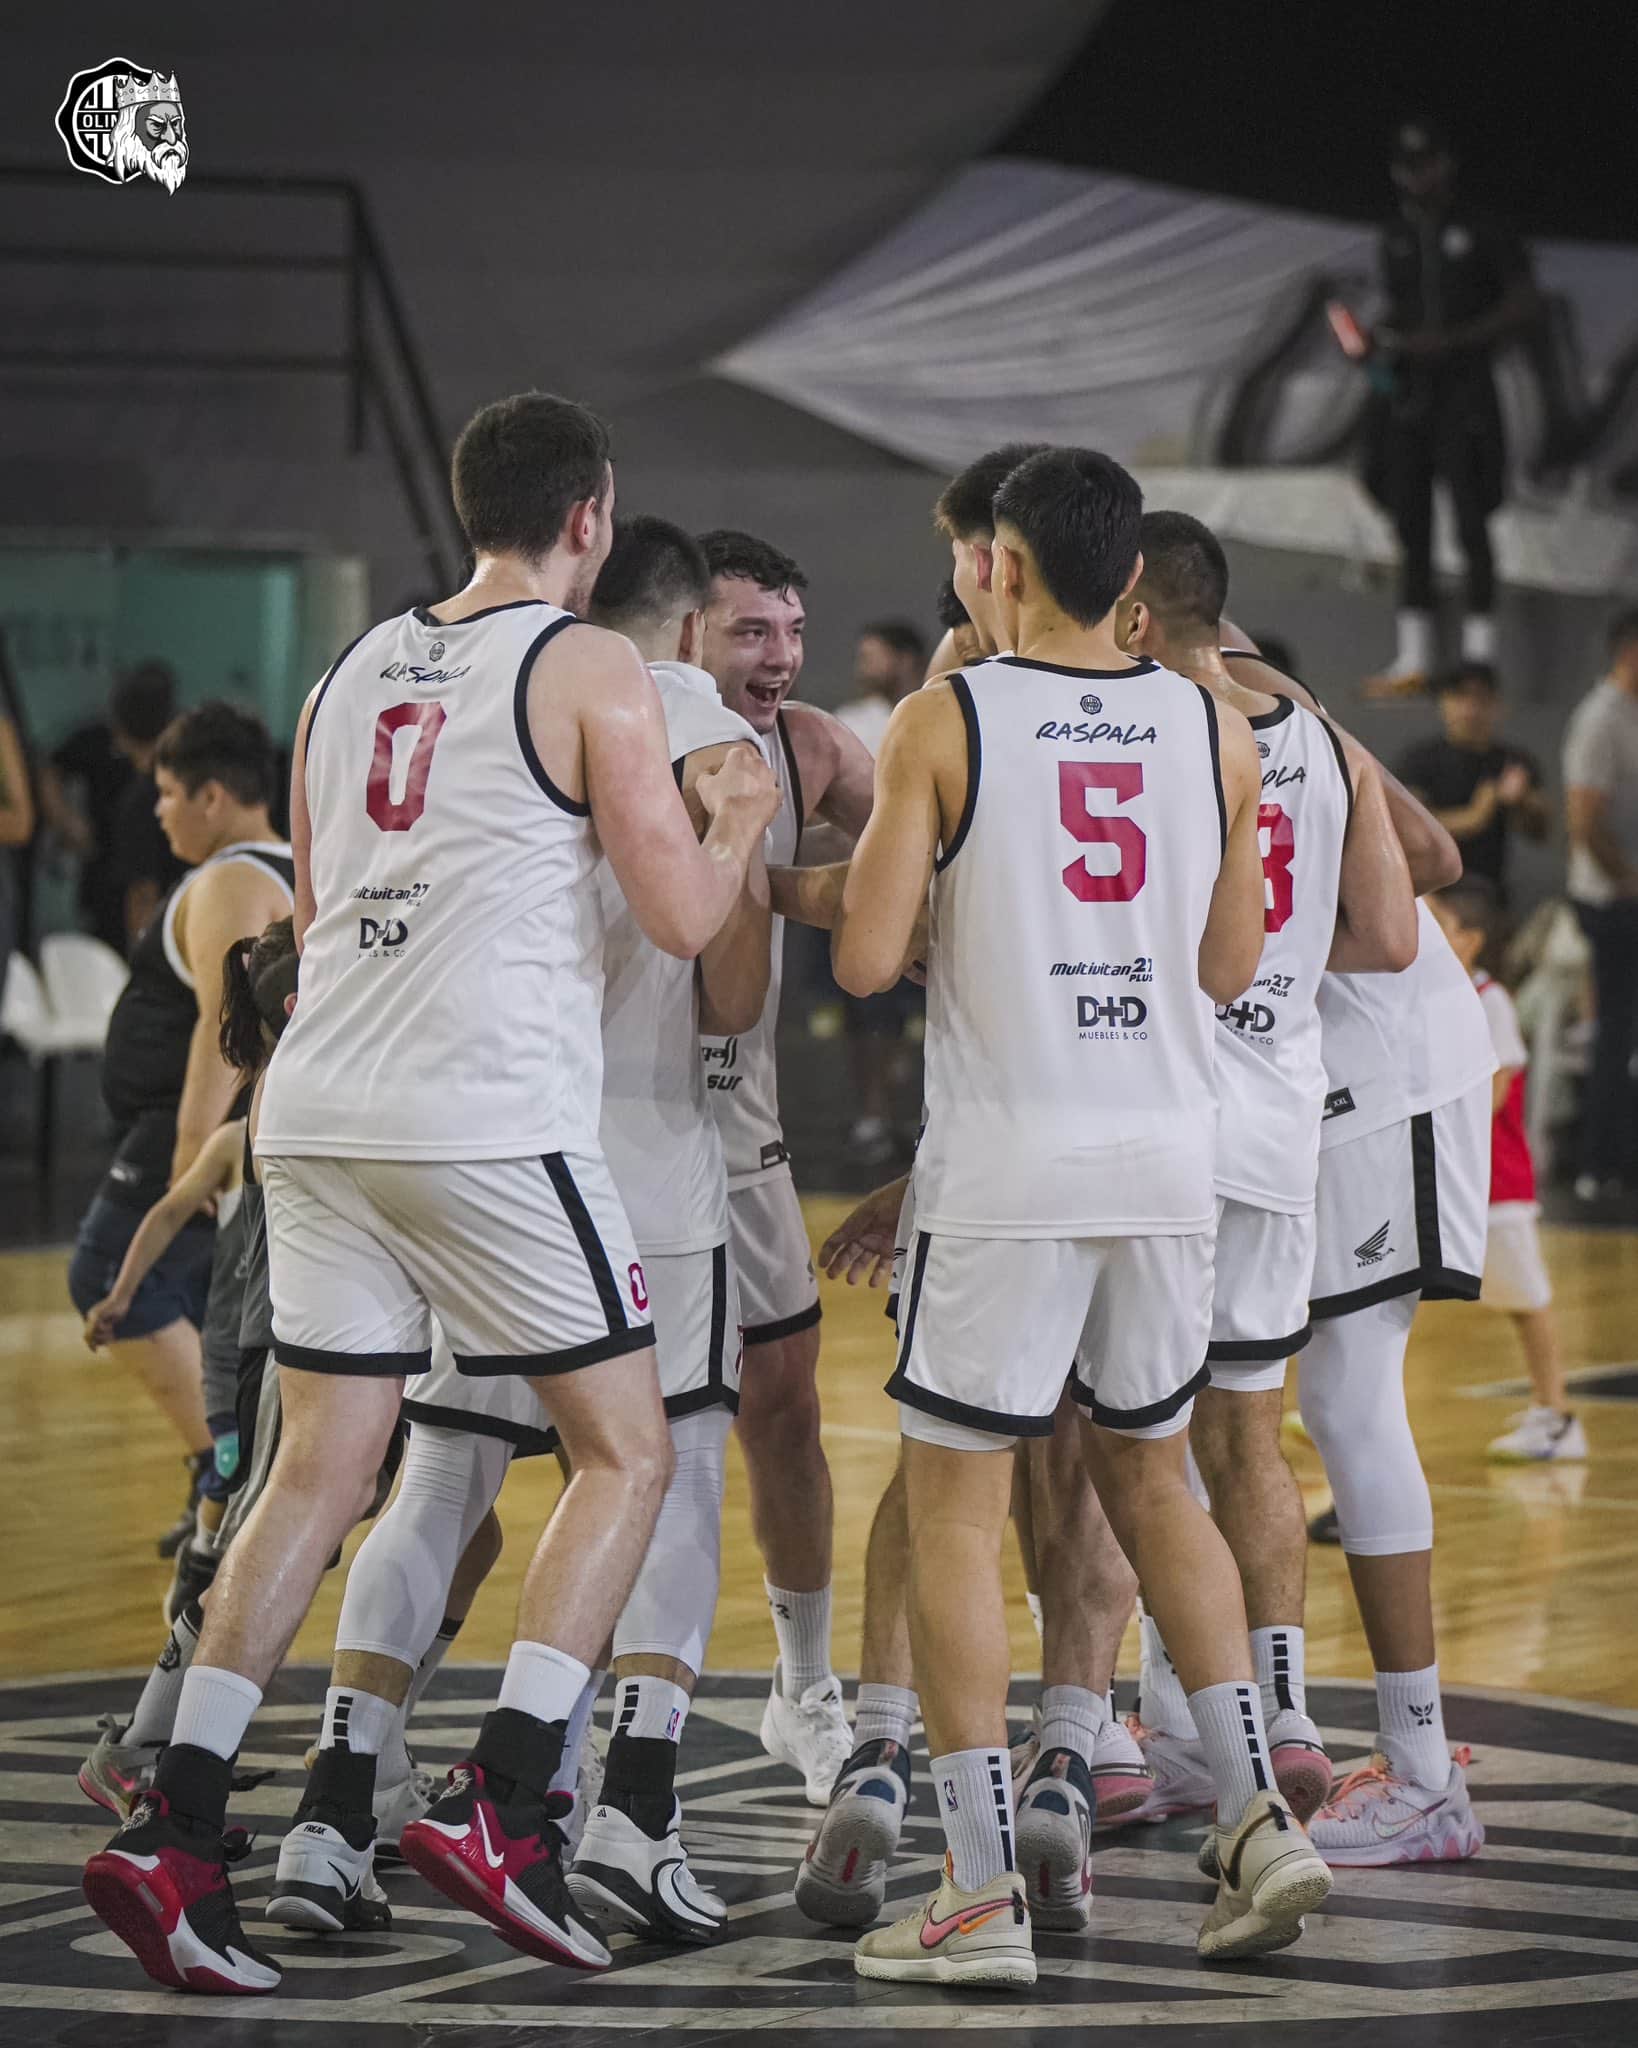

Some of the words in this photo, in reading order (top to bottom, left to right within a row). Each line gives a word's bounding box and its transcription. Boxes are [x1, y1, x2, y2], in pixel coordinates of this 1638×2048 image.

[1036, 721, 1158, 746] RASPALA
[366, 701, 447, 832] 0
[1058, 760, 1147, 902] 5
[1268, 986, 1289, 998] PLUS
[1077, 995, 1148, 1028] D+D
[1079, 1031, 1120, 1041] MUEBLES
[1132, 1031, 1148, 1041] CO
[1357, 1247, 1396, 1268] HONA
